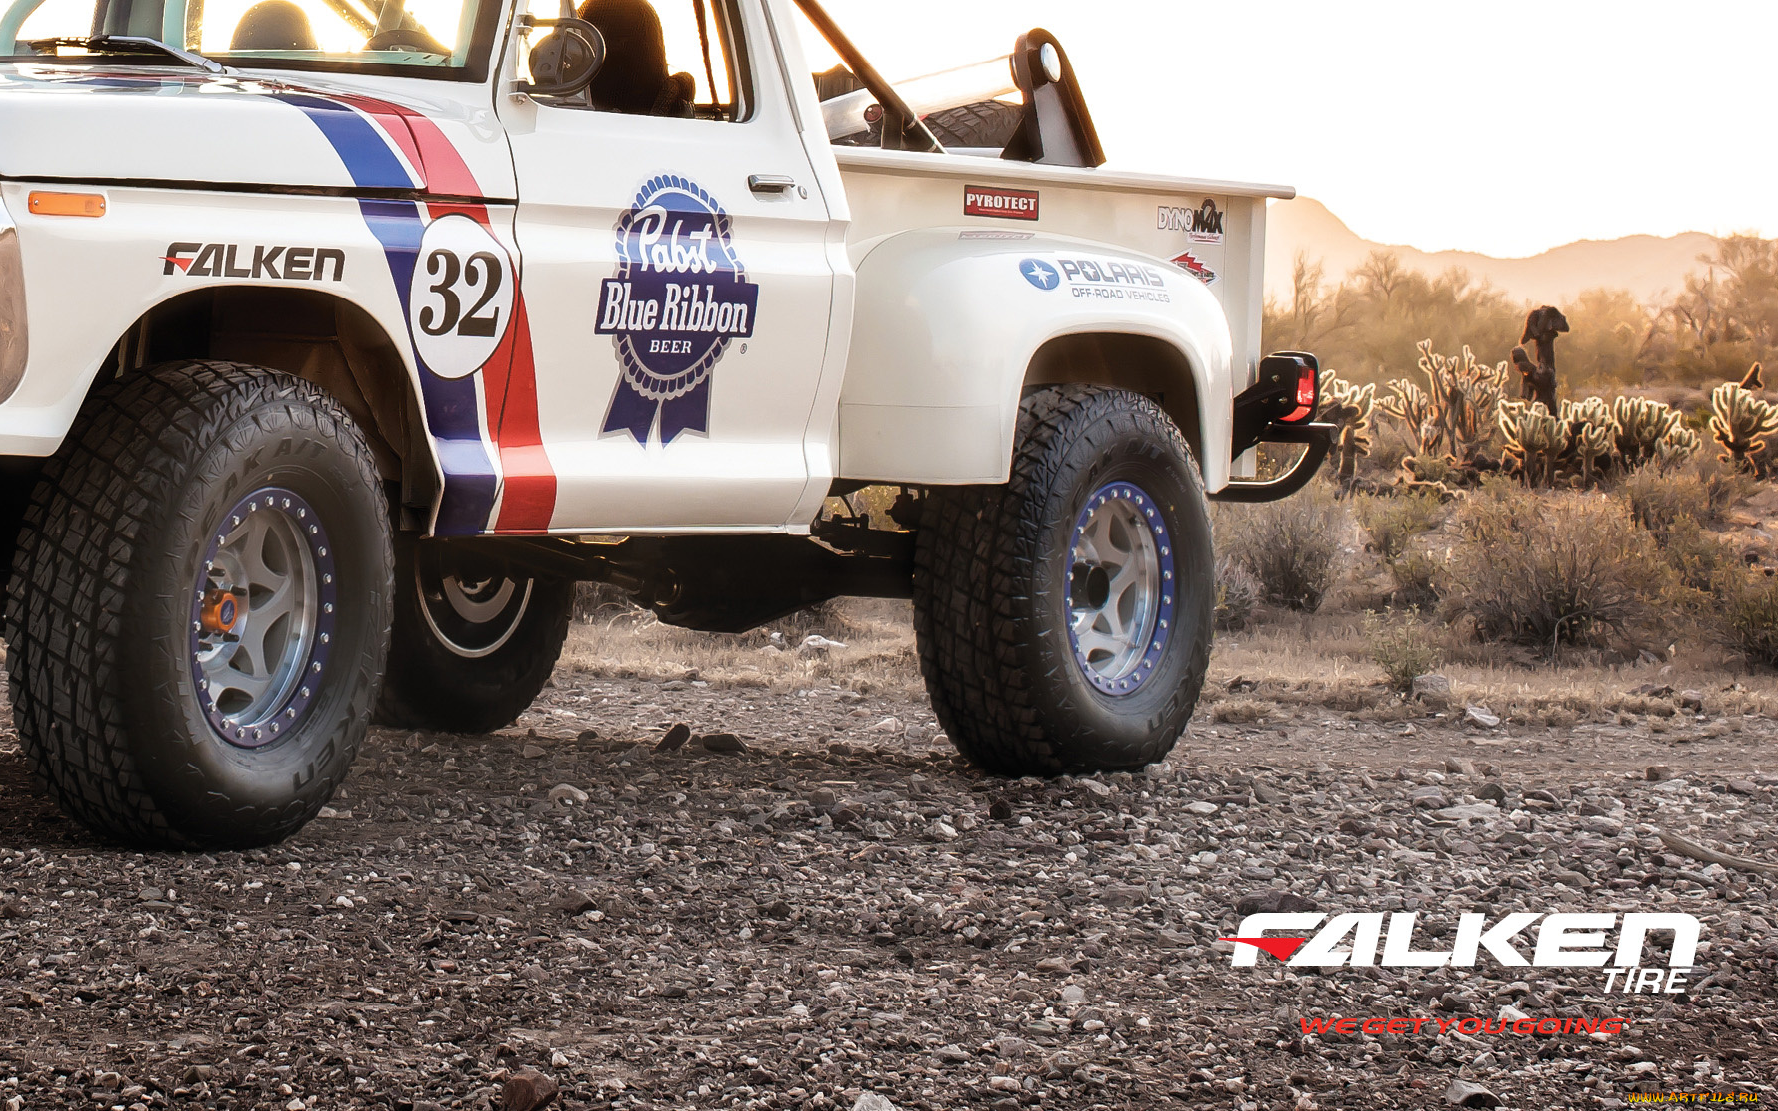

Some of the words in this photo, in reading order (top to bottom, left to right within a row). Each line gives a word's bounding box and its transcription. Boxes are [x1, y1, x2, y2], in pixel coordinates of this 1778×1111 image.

[966, 193, 1037, 211] PYROTECT
[1157, 200, 1224, 234] DYNOMAX
[633, 204, 717, 274] Pabst
[159, 242, 346, 282] FALKEN
[1057, 259, 1165, 287] POLARIS
[419, 249, 502, 338] 32
[600, 282, 659, 331] Blue
[659, 283, 748, 334] Ribbon
[1124, 290, 1171, 303] VEHICLES
[649, 339, 692, 354] BEER
[273, 437, 329, 459] A/T
